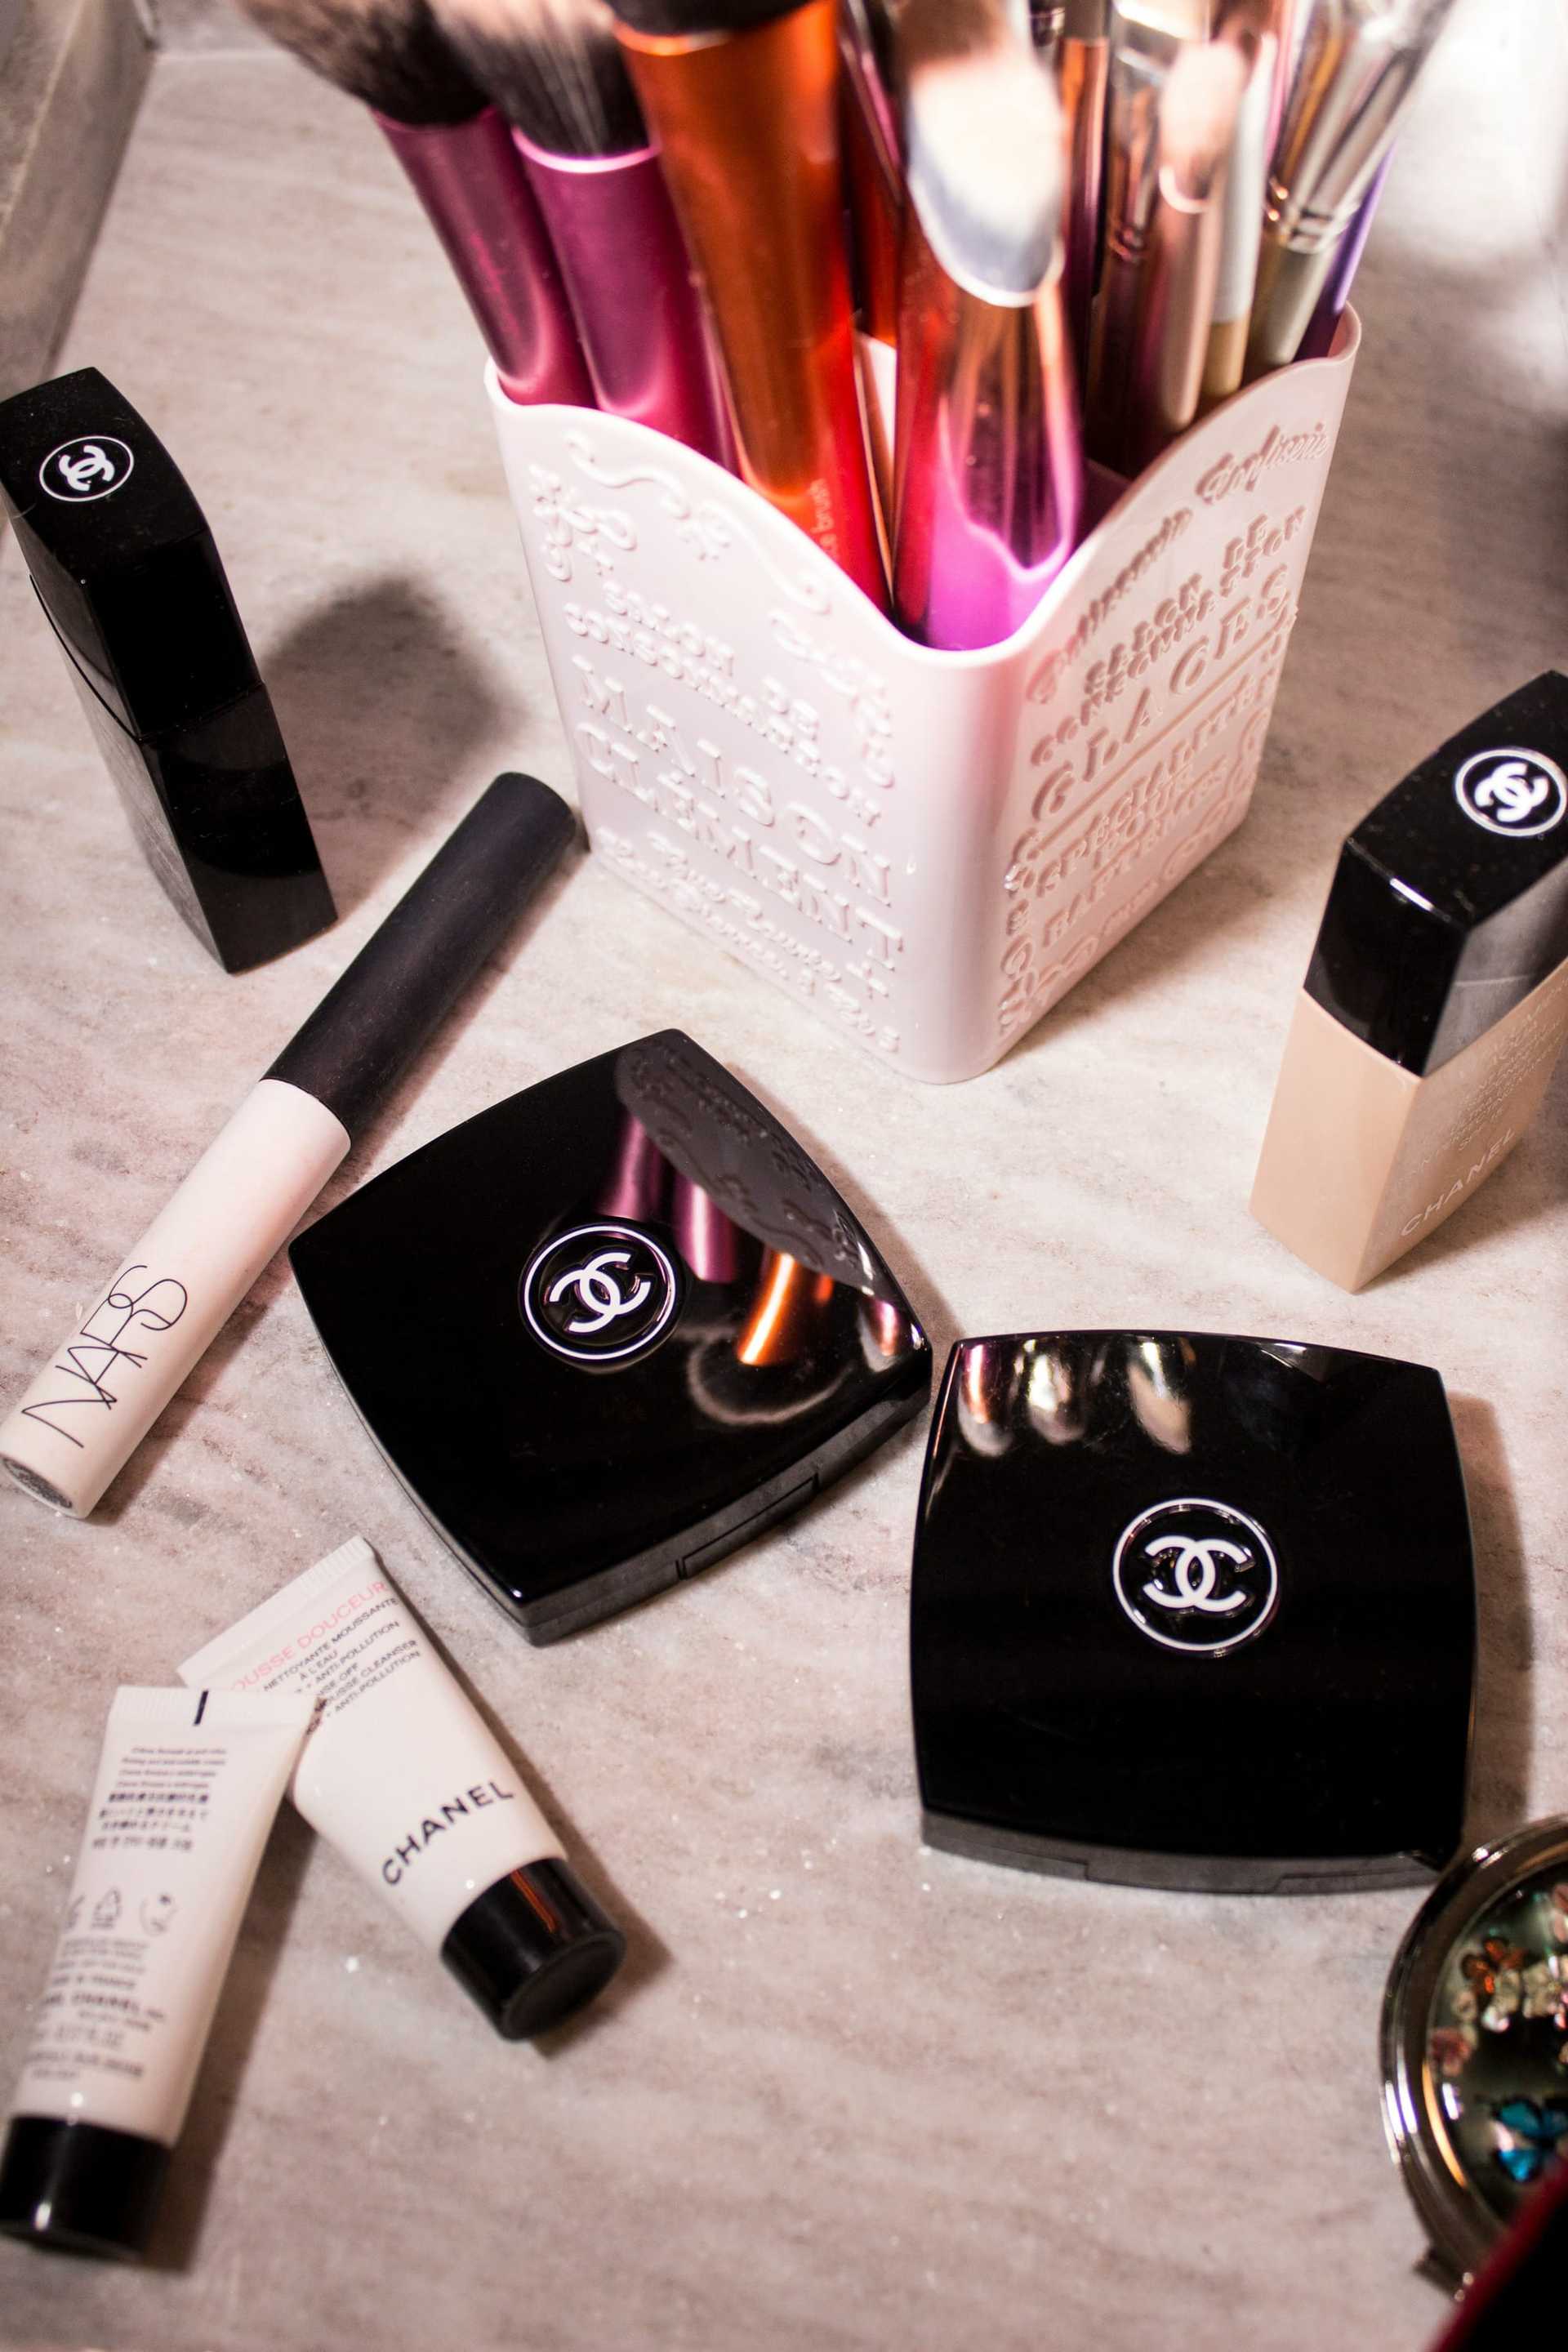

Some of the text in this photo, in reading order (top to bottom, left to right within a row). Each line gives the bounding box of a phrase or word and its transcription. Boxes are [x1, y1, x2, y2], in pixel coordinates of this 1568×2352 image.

[1031, 563, 1288, 822] GLACES
[572, 655, 893, 907] MAISON
[1401, 1127, 1516, 1236] CHANEL
[21, 1264, 188, 1449] NARS
[232, 1580, 389, 1690] OUSSE DOUCEUR
[381, 1781, 515, 1886] CHANEL
